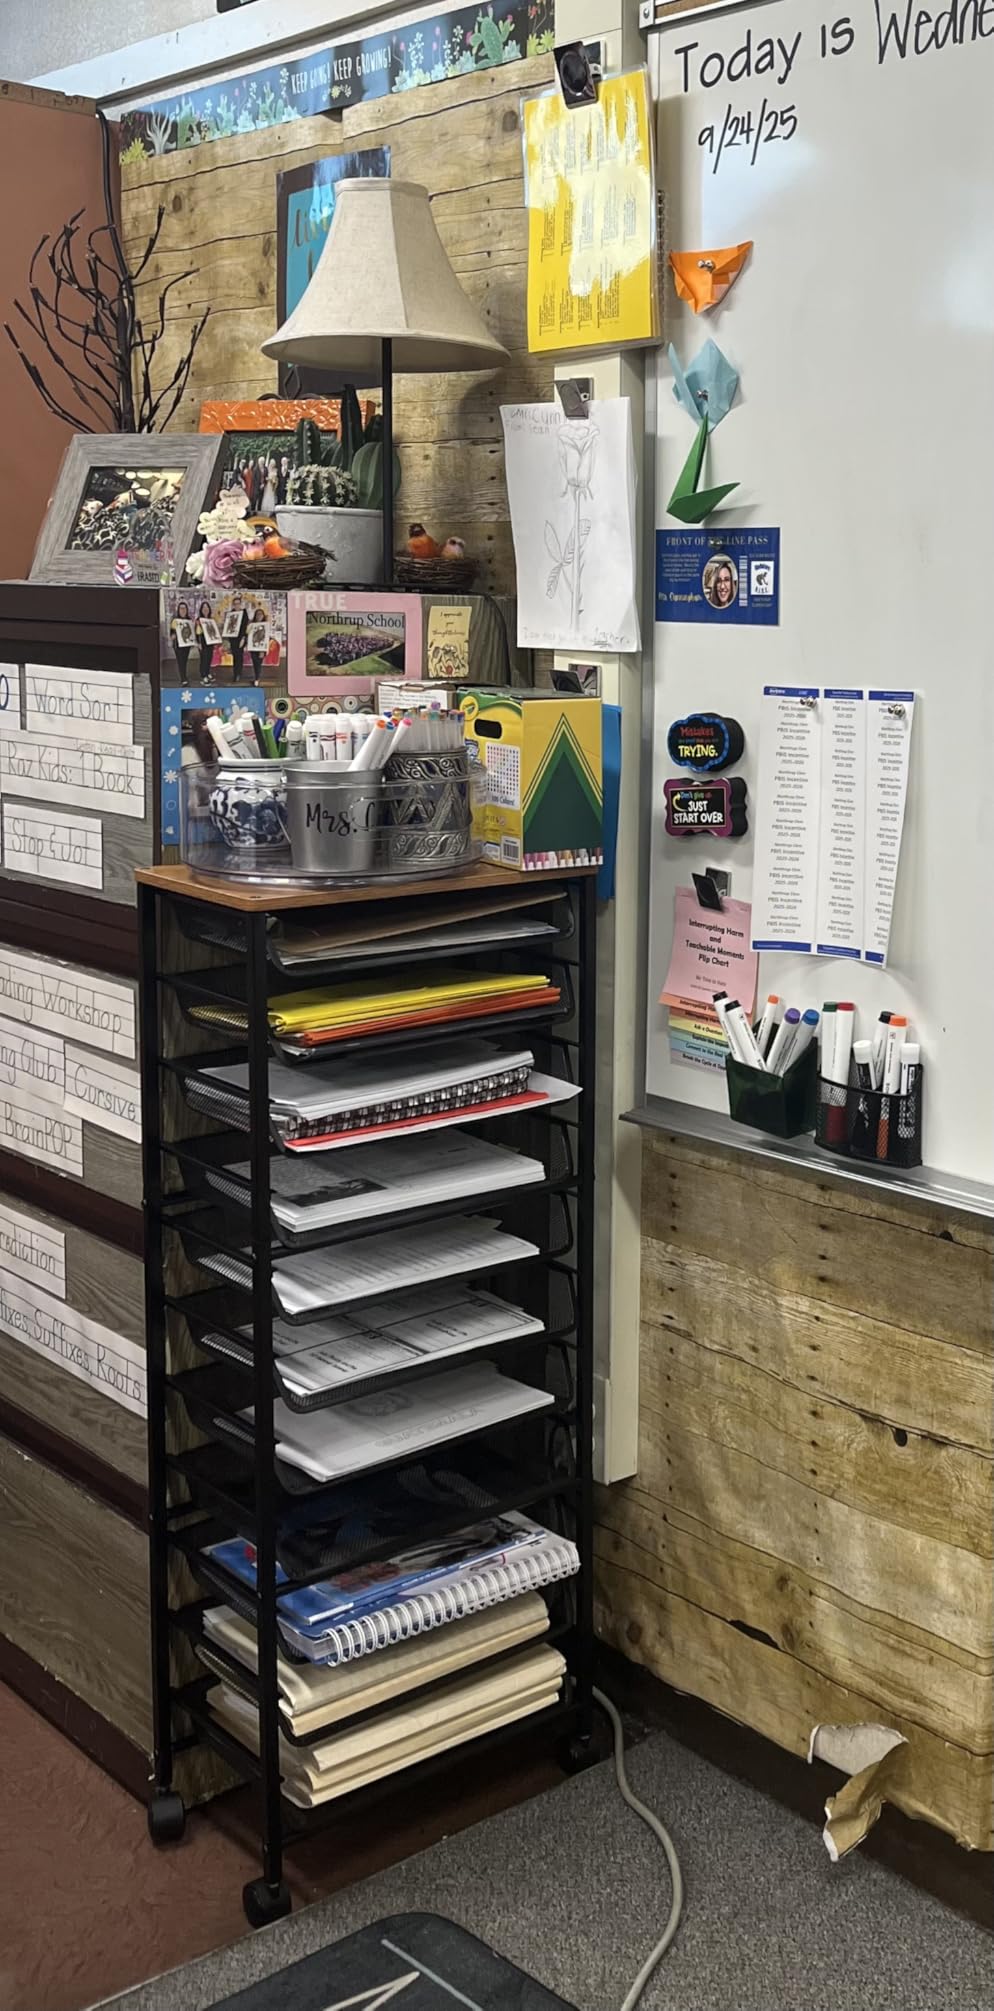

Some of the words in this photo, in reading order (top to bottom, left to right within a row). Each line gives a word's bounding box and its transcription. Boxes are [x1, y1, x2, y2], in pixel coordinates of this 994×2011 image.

[291, 71, 308, 95] KEEP
[333, 57, 352, 81] KEEP
[355, 45, 392, 77] GROWING!
[674, 29, 802, 93] Today
[698, 98, 797, 174] 9/24/25
[666, 537, 692, 546] FRONT
[694, 537, 705, 546] OF
[726, 536, 747, 545] LINE
[747, 535, 769, 545] PASS
[293, 592, 347, 610] TRUE
[309, 613, 364, 631] Northrup
[366, 614, 405, 629] School
[32, 678, 74, 717] Word
[80, 682, 123, 723] Sort
[680, 726, 714, 737] Mistakes
[678, 744, 718, 758] TRYING.
[8, 741, 33, 778] Raz
[38, 745, 72, 784] Kids:
[93, 753, 135, 795] Book
[306, 803, 358, 836] Mrs.
[673, 812, 699, 824] START
[700, 811, 723, 823] OVER
[688, 800, 708, 812] JUST
[12, 818, 44, 873] Stop
[689, 918, 725, 935] Interrupting
[726, 927, 744, 937] Harm
[685, 939, 716, 953] Teachable
[717, 946, 745, 960] Moments
[698, 953, 710, 963] Flip
[712, 957, 729, 967] Chart
[41, 974, 122, 1051] Workshop
[706, 1027, 723, 1035] Question
[21, 1040, 57, 1083] Club
[74, 1063, 136, 1122] Cursive
[96, 1343, 142, 1400] Roots
